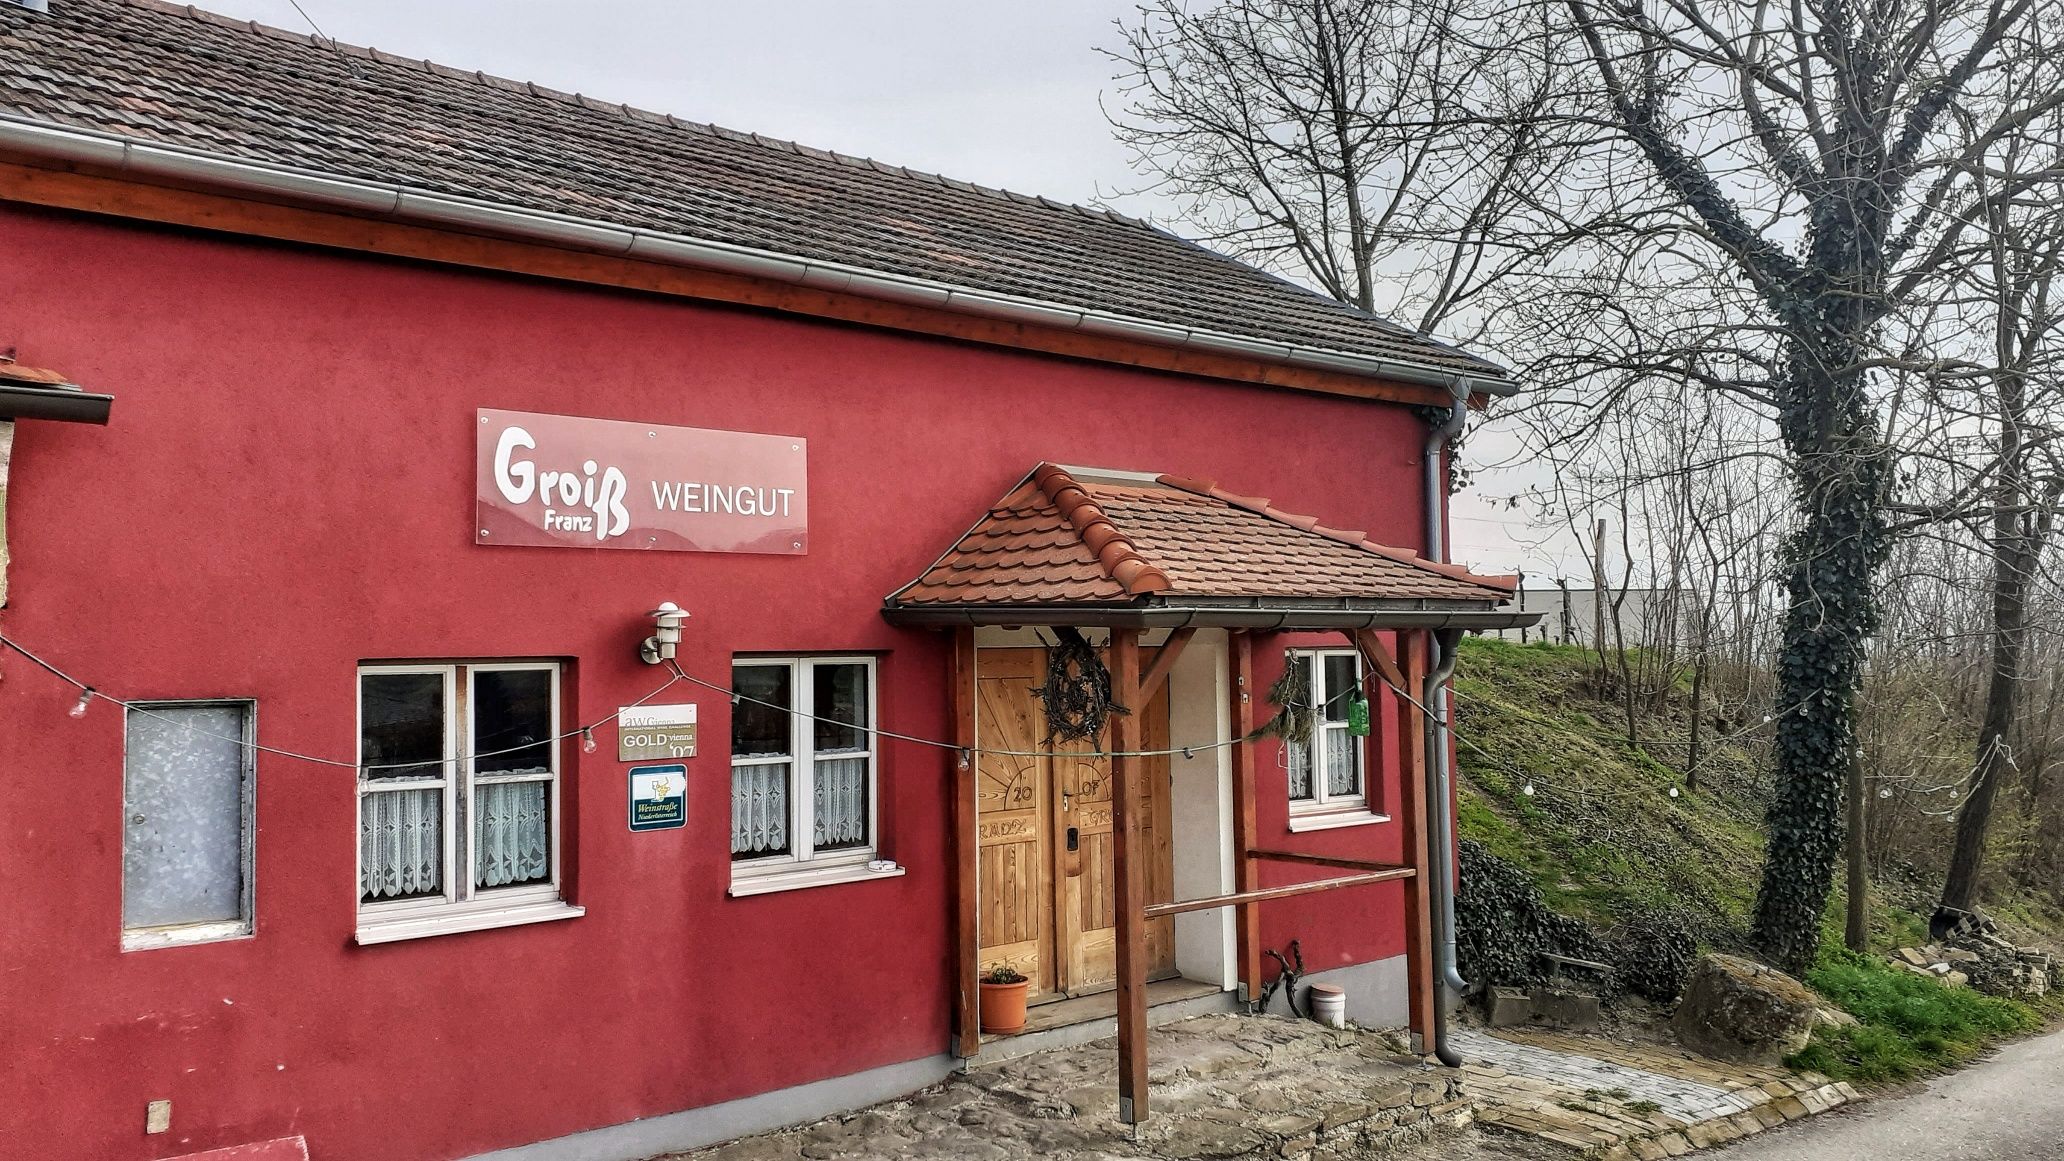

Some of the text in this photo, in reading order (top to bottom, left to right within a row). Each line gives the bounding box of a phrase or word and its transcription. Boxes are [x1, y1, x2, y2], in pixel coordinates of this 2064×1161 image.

[494, 426, 630, 541] Groiß
[651, 480, 795, 517] WEINGUT
[544, 509, 593, 532] Franz
[624, 733, 693, 747] GOLD vienna
[1013, 786, 1033, 802] 20
[638, 801, 678, 813] Weinstraße
